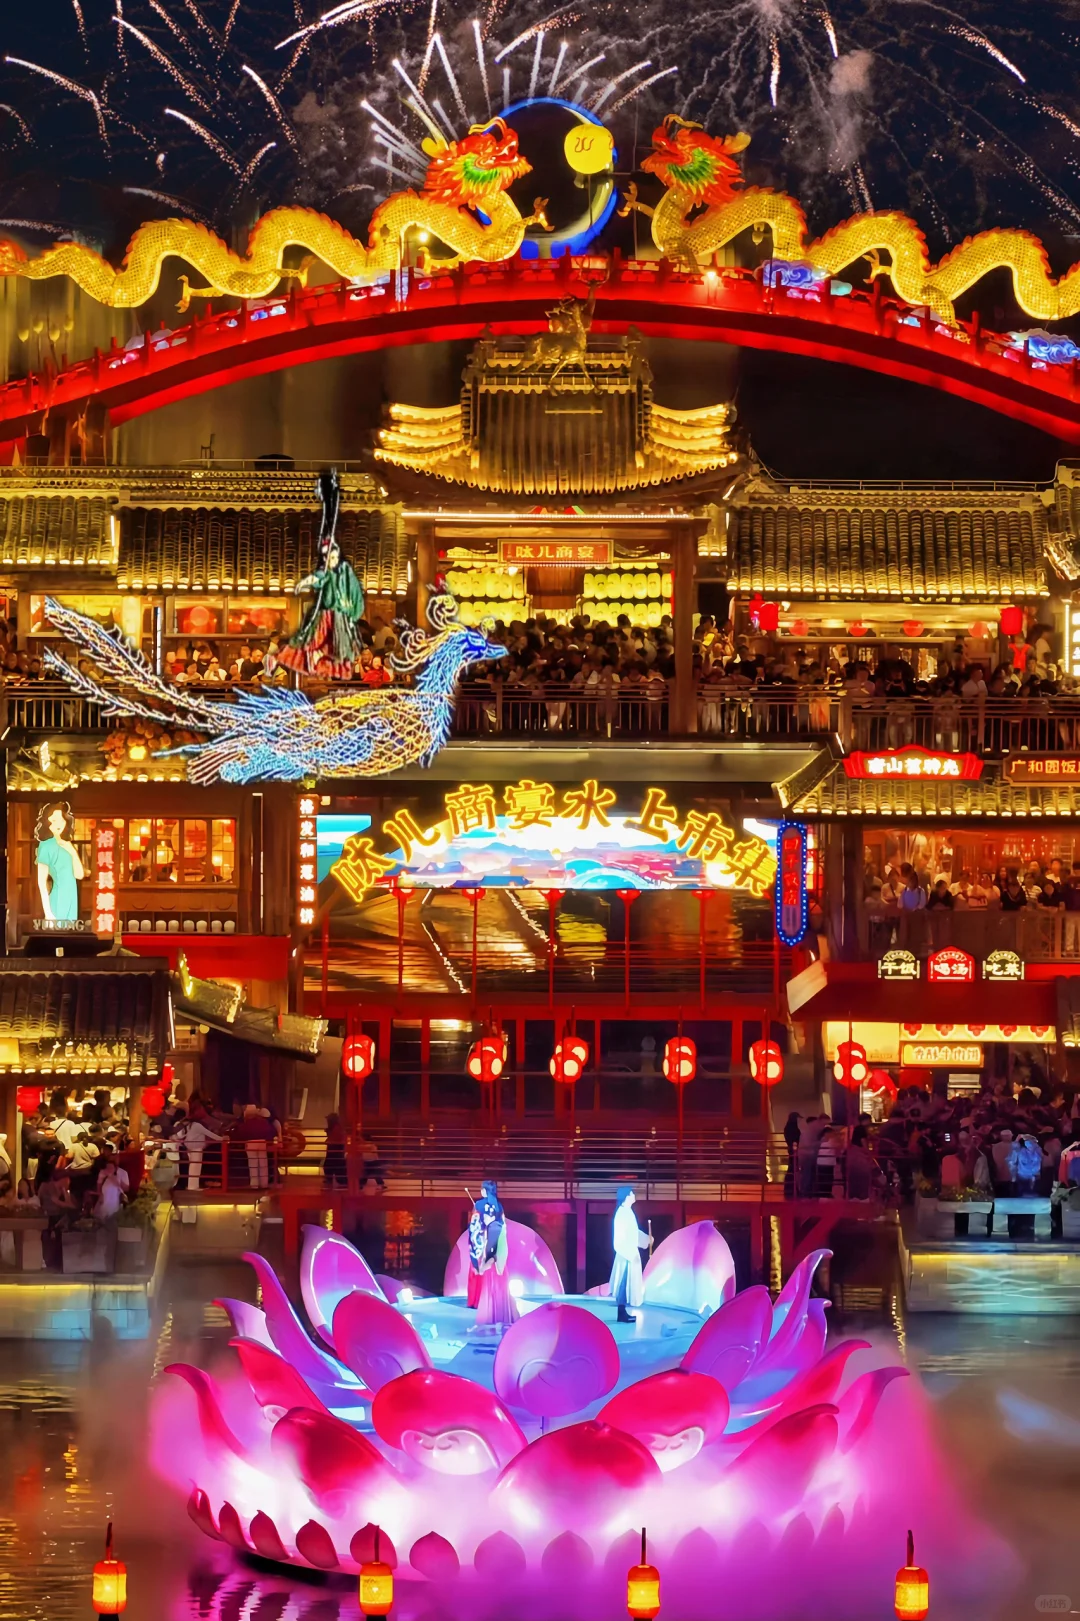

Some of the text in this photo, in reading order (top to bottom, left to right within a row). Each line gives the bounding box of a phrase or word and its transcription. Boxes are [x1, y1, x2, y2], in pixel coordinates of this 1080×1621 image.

[1011, 759, 1080, 773] 广和园饭
[933, 962, 969, 976] 喝汤
[985, 962, 1022, 976] 吃菜
